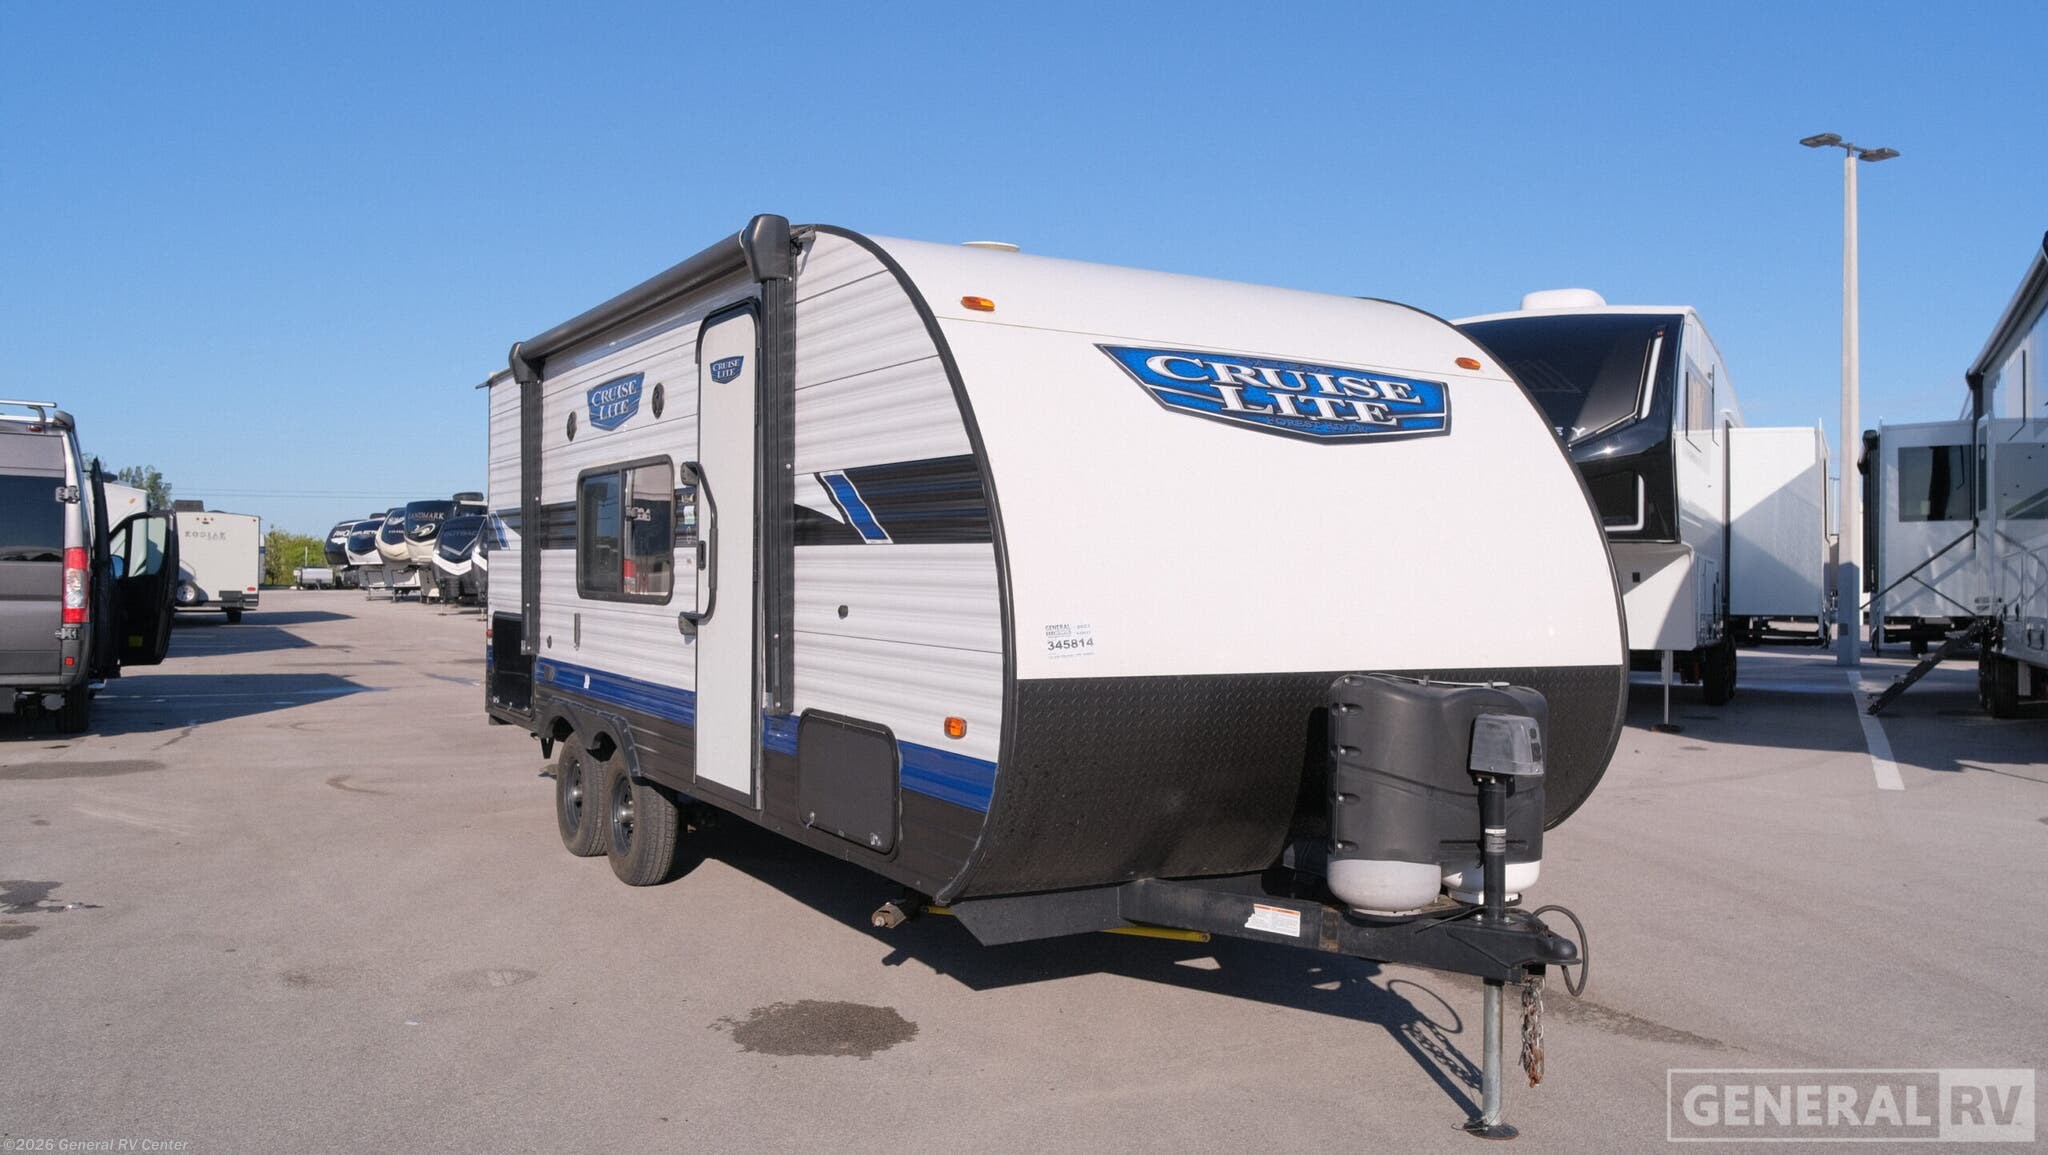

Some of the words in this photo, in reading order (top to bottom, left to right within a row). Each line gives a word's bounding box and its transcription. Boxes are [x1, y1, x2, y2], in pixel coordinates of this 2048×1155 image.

[712, 359, 739, 371] CRUISE
[717, 369, 737, 379] LITE
[1145, 354, 1422, 405] CRUISE
[591, 380, 637, 407] CRUISE
[600, 399, 629, 420] LITE
[1209, 384, 1399, 426] LITE
[1047, 638, 1095, 651] 345814
